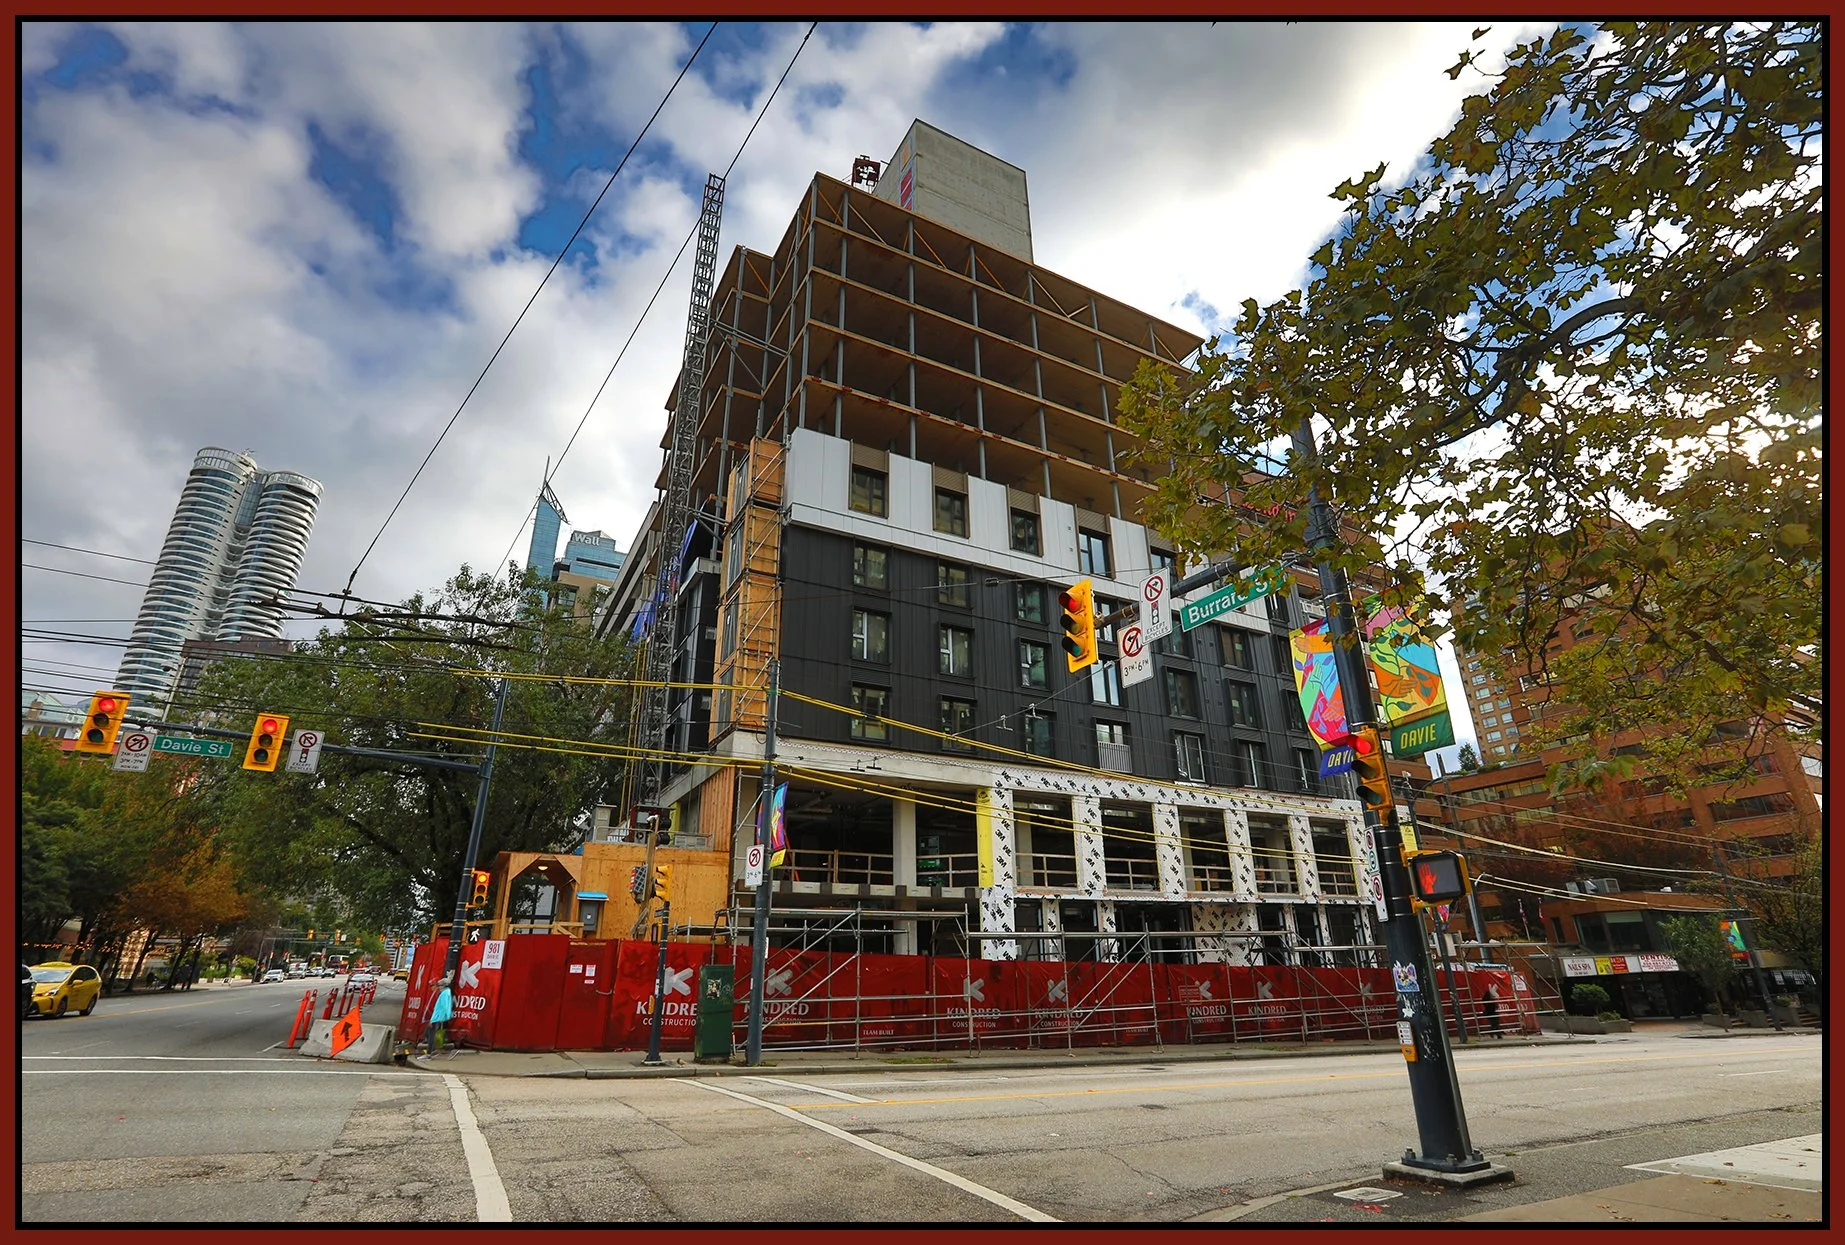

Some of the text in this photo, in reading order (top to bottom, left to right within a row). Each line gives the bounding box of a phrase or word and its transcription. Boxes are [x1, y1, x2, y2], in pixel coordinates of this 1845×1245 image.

[574, 532, 600, 546] Wall
[1144, 625, 1169, 640] BICYCLES
[1146, 621, 1166, 634] EXCEPT
[1400, 723, 1437, 750] DAVIE
[160, 738, 225, 755] Davie St
[1328, 750, 1354, 768] DAVI
[488, 943, 500, 954] 981
[453, 995, 486, 1010] NDRED
[744, 1002, 809, 1016] KNDRED
[1247, 1005, 1287, 1016] KINDRED
